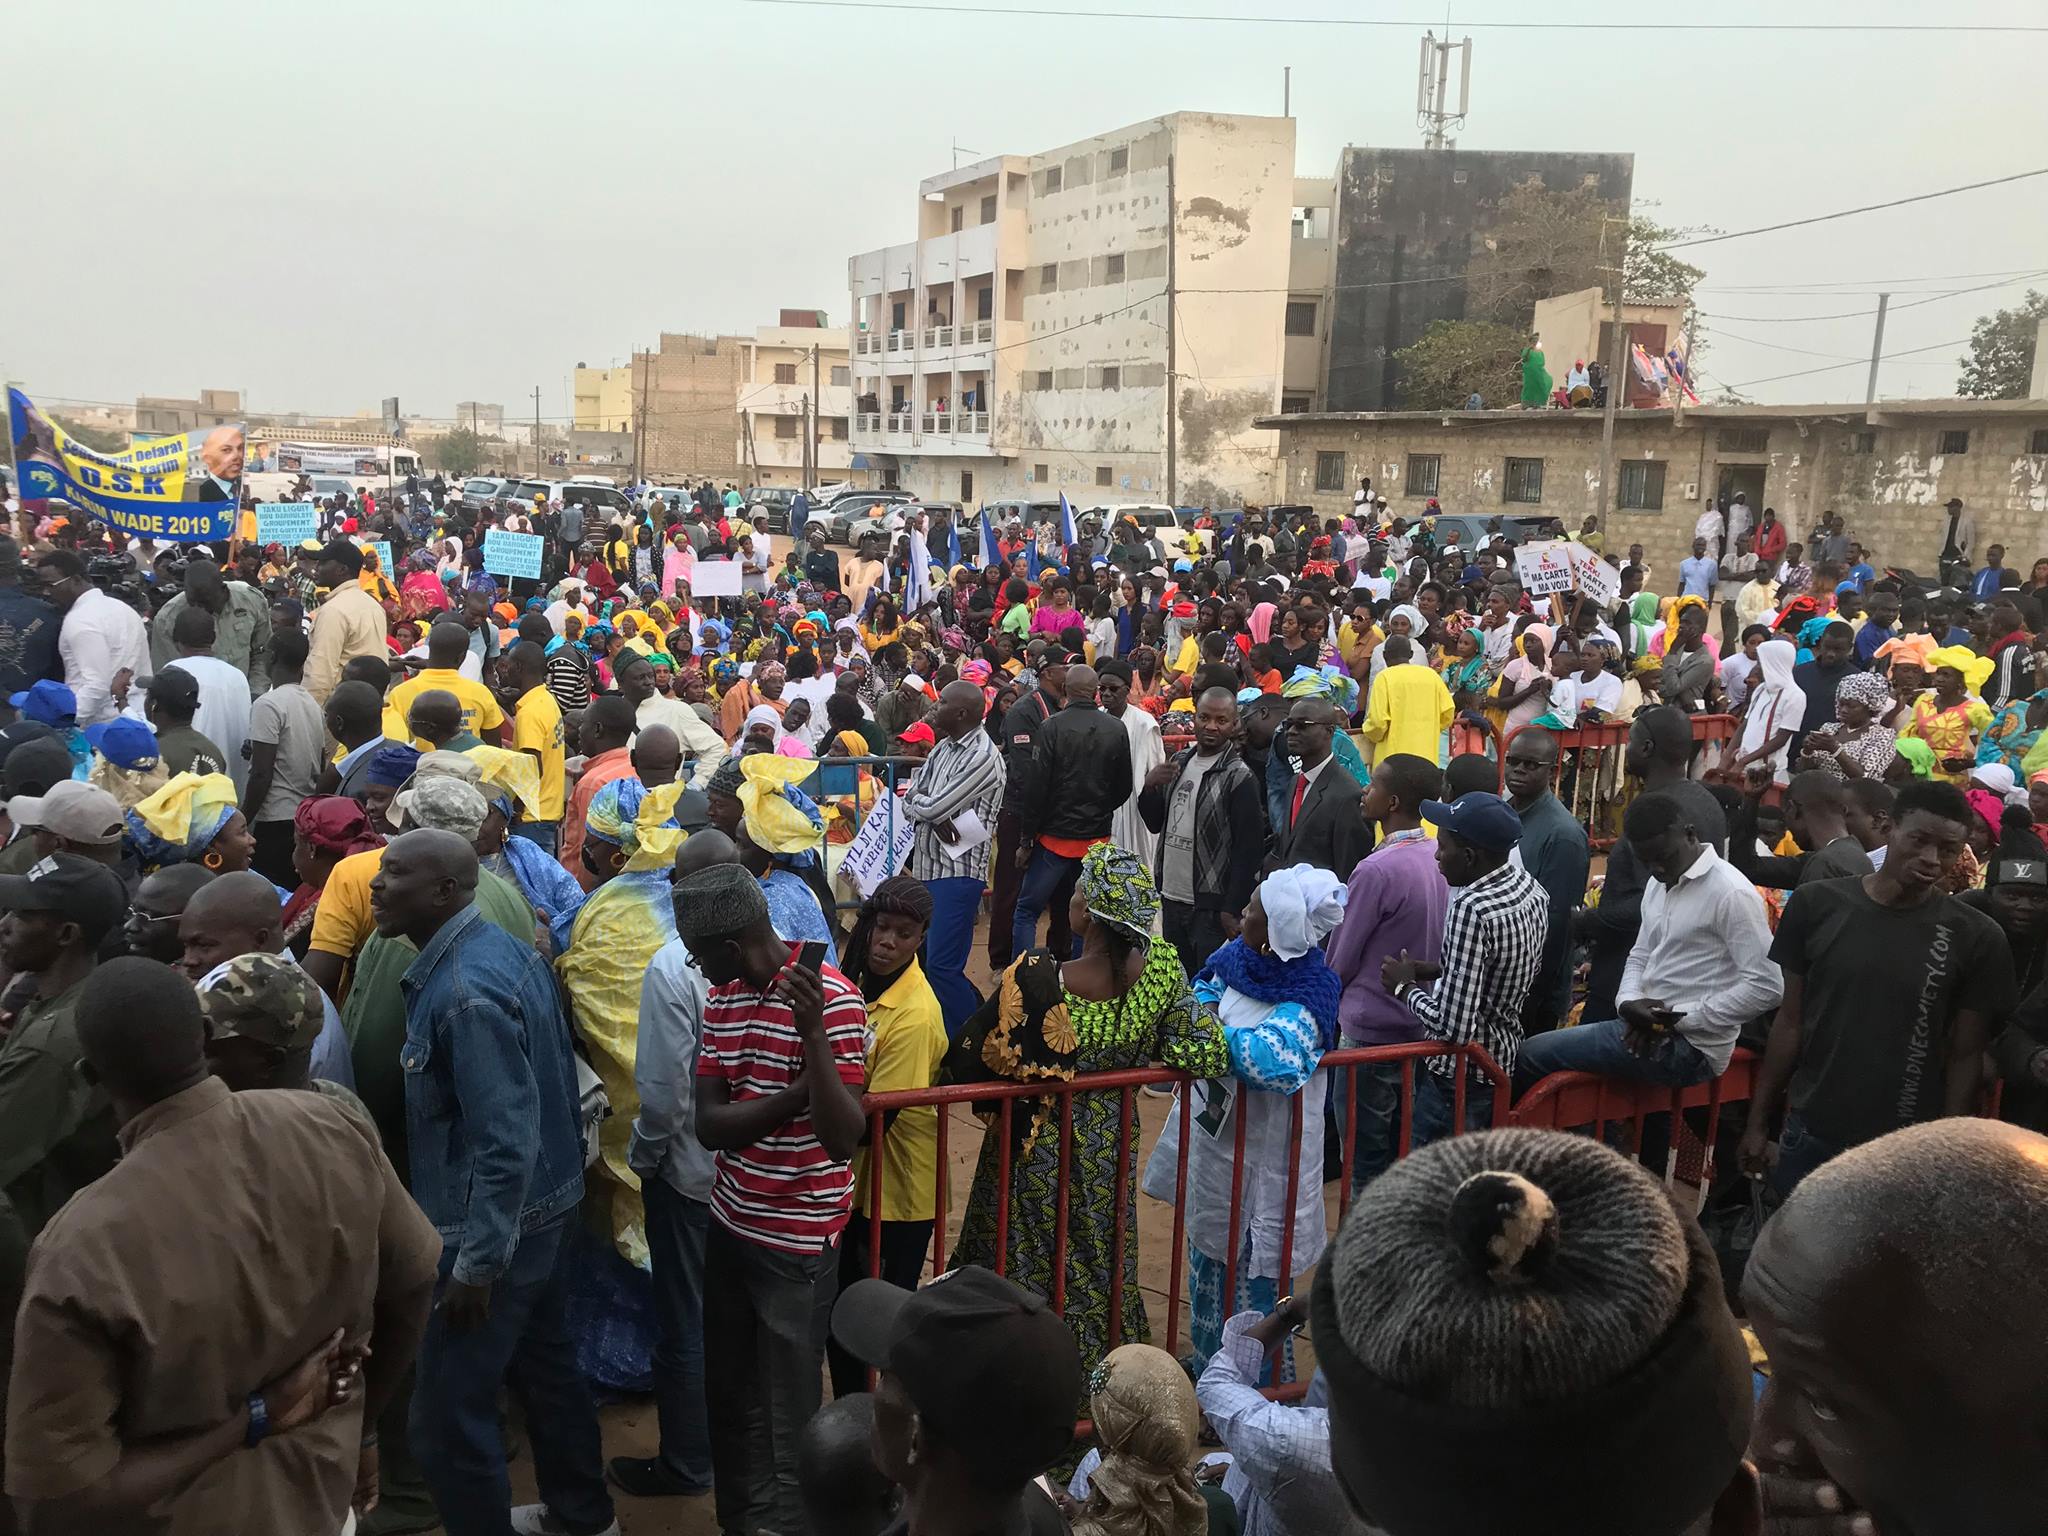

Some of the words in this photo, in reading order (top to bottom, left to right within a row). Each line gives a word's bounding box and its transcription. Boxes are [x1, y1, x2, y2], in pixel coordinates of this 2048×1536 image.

[136, 439, 184, 462] Defarat
[64, 483, 109, 521] KARIM
[111, 509, 164, 533] WADE
[168, 516, 211, 534] 2019
[1538, 562, 1558, 571] TEKKI
[1579, 558, 1601, 578] TEKKI
[1531, 572, 1543, 582] MA
[1538, 583, 1550, 592] MA
[1551, 579, 1570, 590] VOIX
[1583, 581, 1602, 599] VOIX
